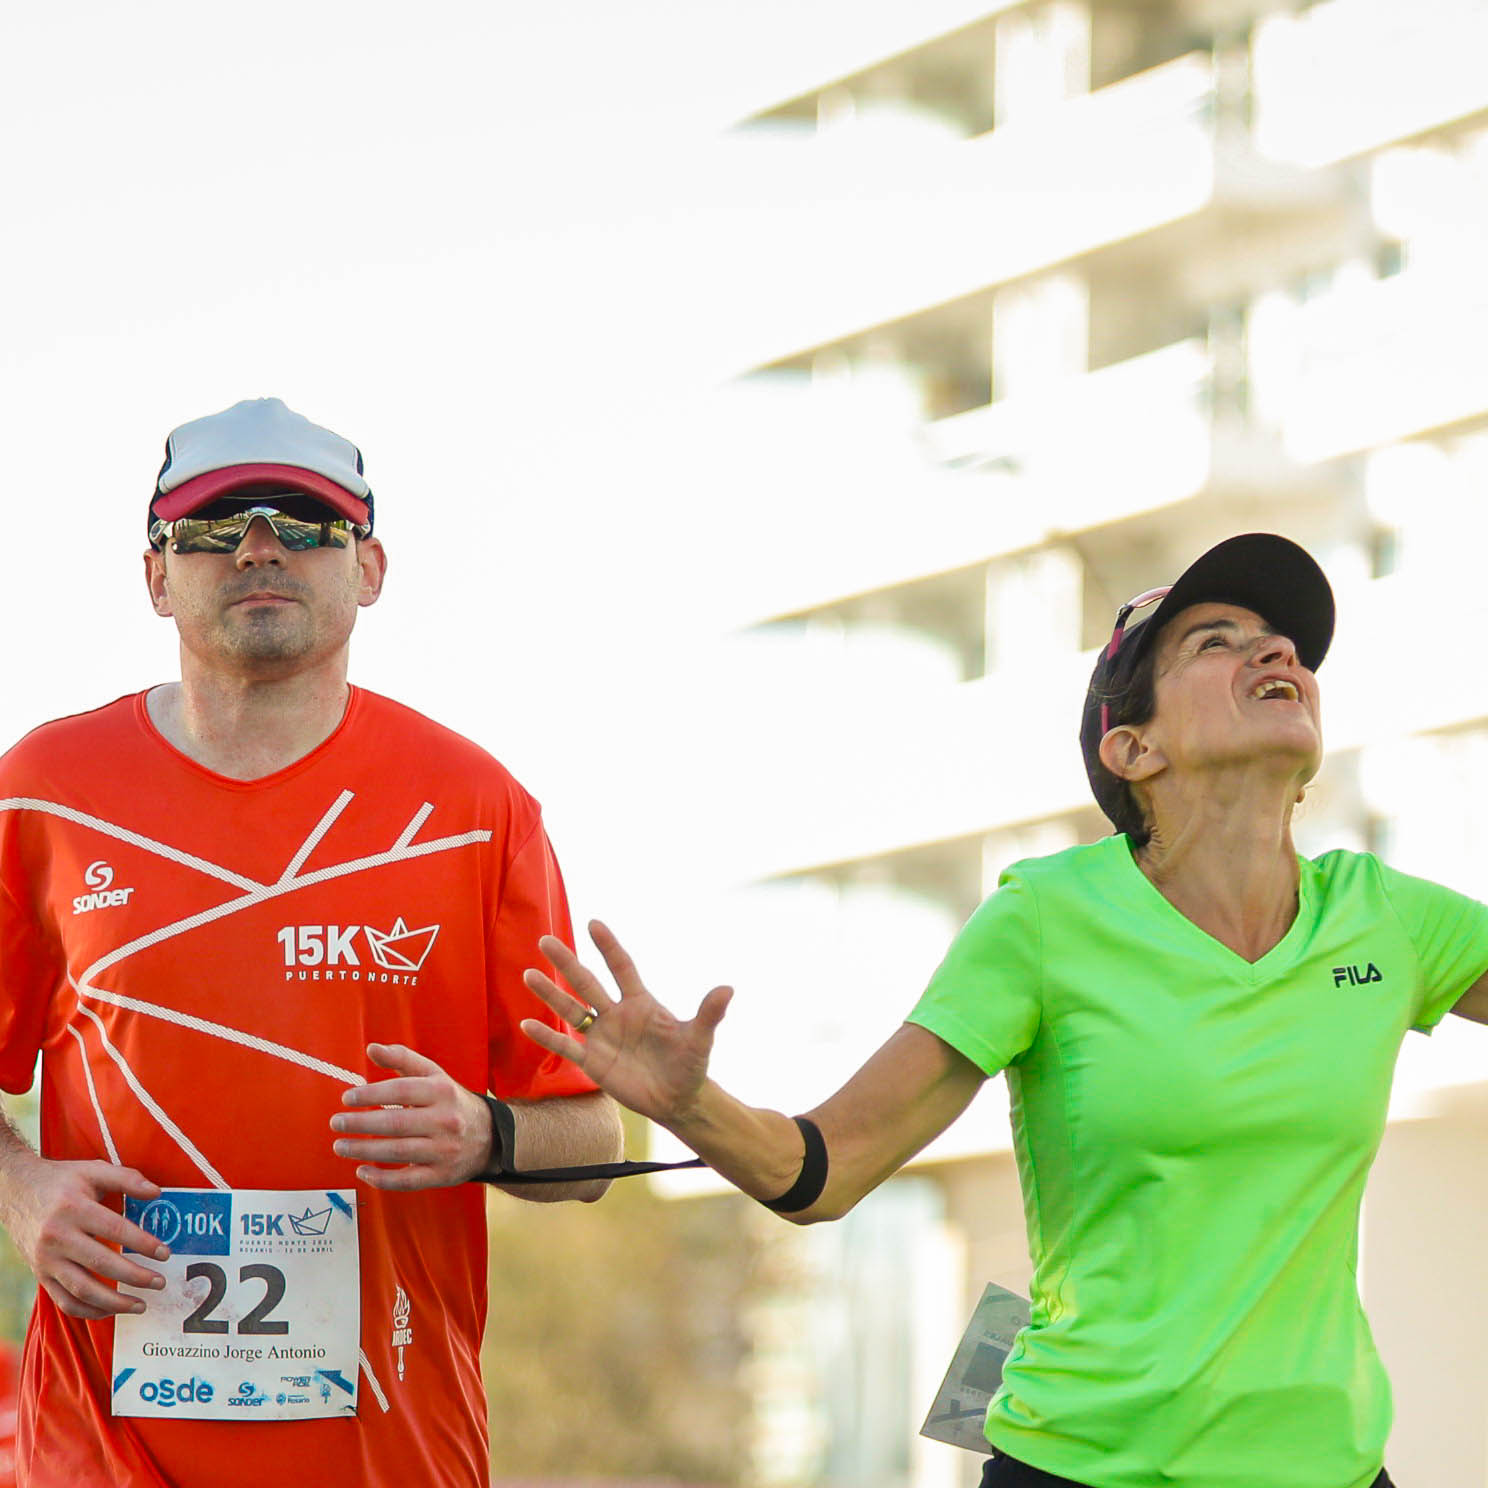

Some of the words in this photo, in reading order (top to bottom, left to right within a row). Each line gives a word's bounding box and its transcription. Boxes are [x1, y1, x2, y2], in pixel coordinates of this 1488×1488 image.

[277, 925, 361, 966] 15K
[285, 970, 360, 981] PUERTO
[368, 972, 417, 986] NORTE
[1332, 962, 1383, 988] FILA
[184, 1212, 225, 1236] 10K
[240, 1213, 284, 1236] 15K
[183, 1262, 289, 1335] 22
[142, 1342, 220, 1358] Giovazzino
[223, 1345, 263, 1362] Jorge
[267, 1345, 326, 1359] Antonio
[139, 1376, 214, 1404] osde
